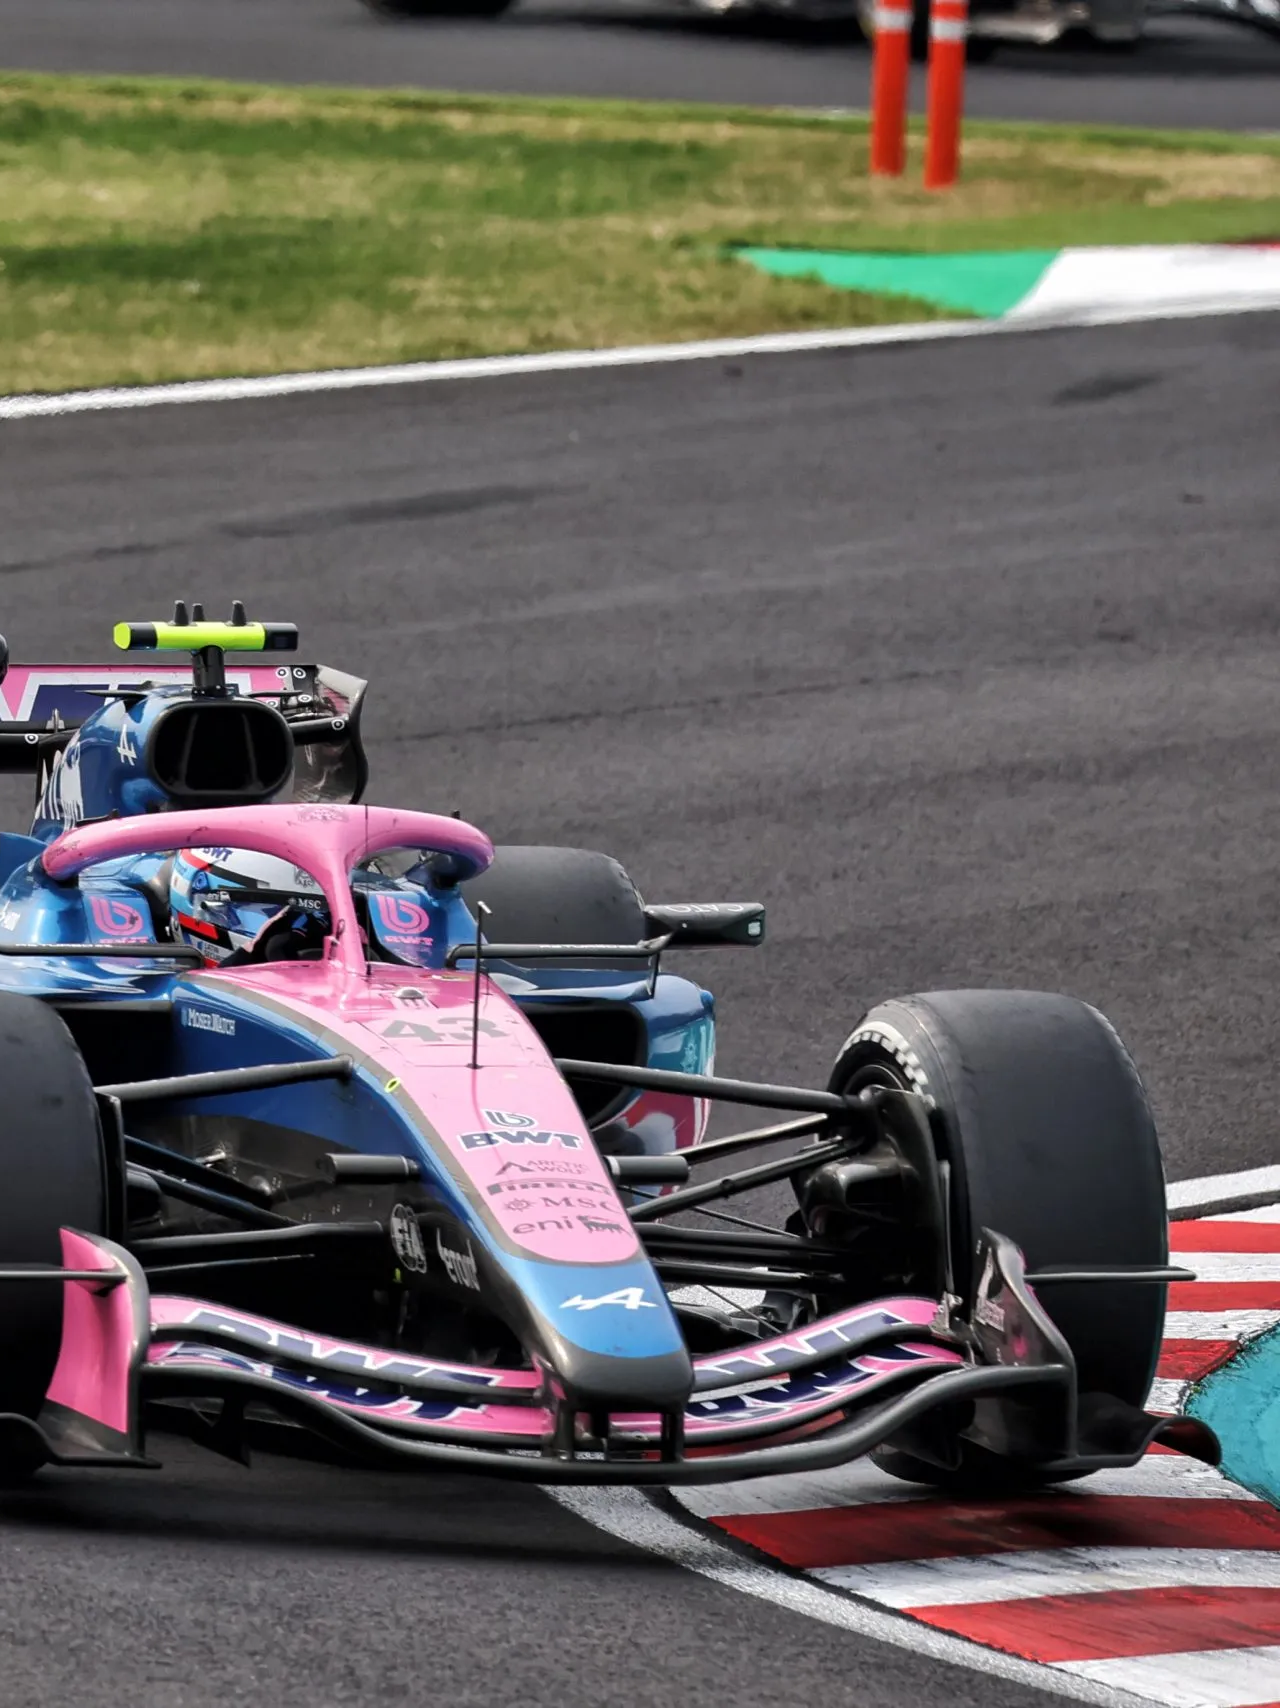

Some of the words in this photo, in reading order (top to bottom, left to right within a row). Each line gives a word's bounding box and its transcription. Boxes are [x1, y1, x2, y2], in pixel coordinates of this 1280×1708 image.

[298, 897, 322, 910] MSC
[381, 1016, 509, 1042] 43
[457, 1129, 582, 1151] BWT
[512, 1216, 574, 1235] eni
